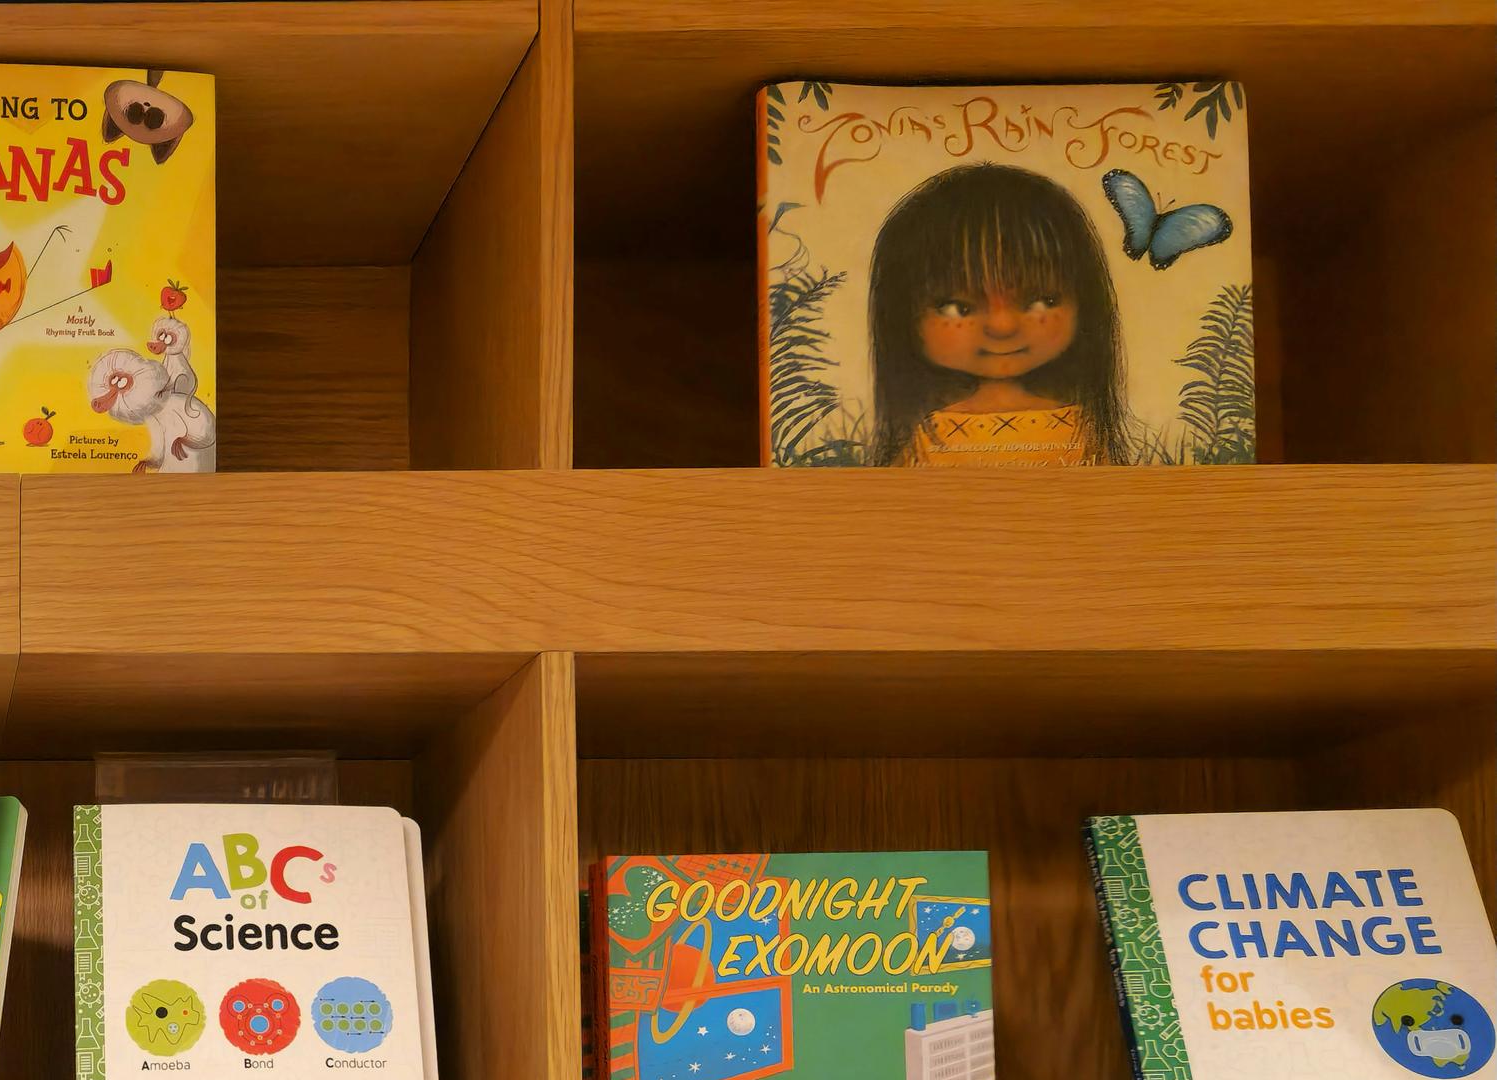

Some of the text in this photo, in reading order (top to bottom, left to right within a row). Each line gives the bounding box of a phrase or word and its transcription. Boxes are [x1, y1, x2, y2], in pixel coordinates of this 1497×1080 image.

[51, 98, 87, 120] TO
[1066, 106, 1222, 174] FOREST
[51, 450, 87, 460] Estrela
[169, 832, 337, 904] ABCs
[240, 890, 269, 910] of
[646, 877, 928, 922] GOODNIGHT
[1178, 869, 1423, 911] CLIMATE
[173, 914, 339, 951] Science
[1188, 916, 1442, 959] CHANGE
[717, 932, 954, 976] EXOMOON
[803, 983, 958, 995] An Astronomical Parody
[1200, 965, 1255, 993] for
[1207, 1001, 1335, 1030] babies
[141, 1059, 191, 1071] Amoeba
[244, 1059, 274, 1069] Bond
[325, 1058, 387, 1069] Conductor
